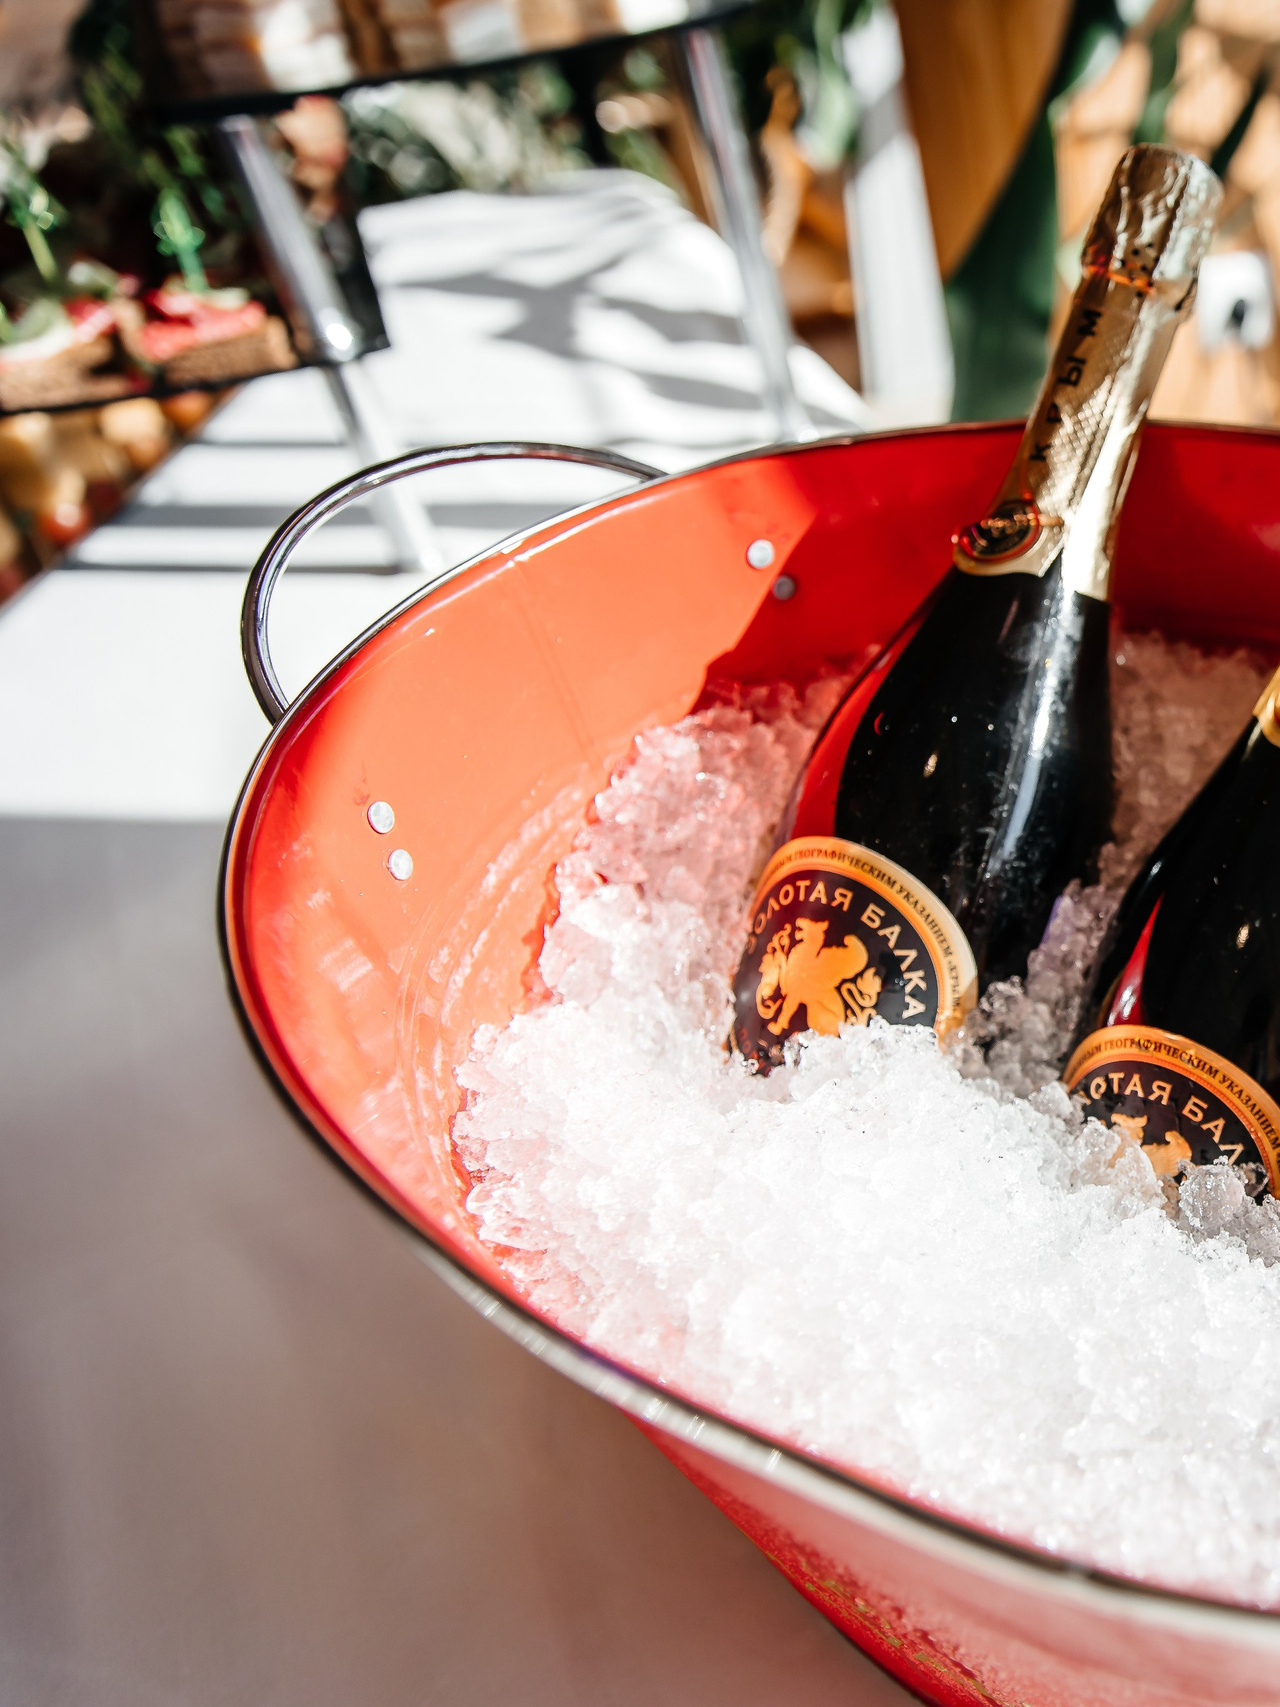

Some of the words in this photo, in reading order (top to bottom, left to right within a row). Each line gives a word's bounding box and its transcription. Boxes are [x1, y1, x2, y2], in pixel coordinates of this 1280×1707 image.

[1029, 308, 1102, 461] КРЫМ
[794, 848, 897, 889] ГЕОГРАФИЧЕСКИМ
[896, 882, 953, 958] УКАЗАНИЕМ
[861, 903, 927, 1019] БАЛКА
[1104, 1036, 1219, 1078] ГЕОГРАФИЧЕСКИМ
[1080, 1072, 1173, 1106] ОТАЯ
[1181, 1094, 1244, 1166] БАЛ
